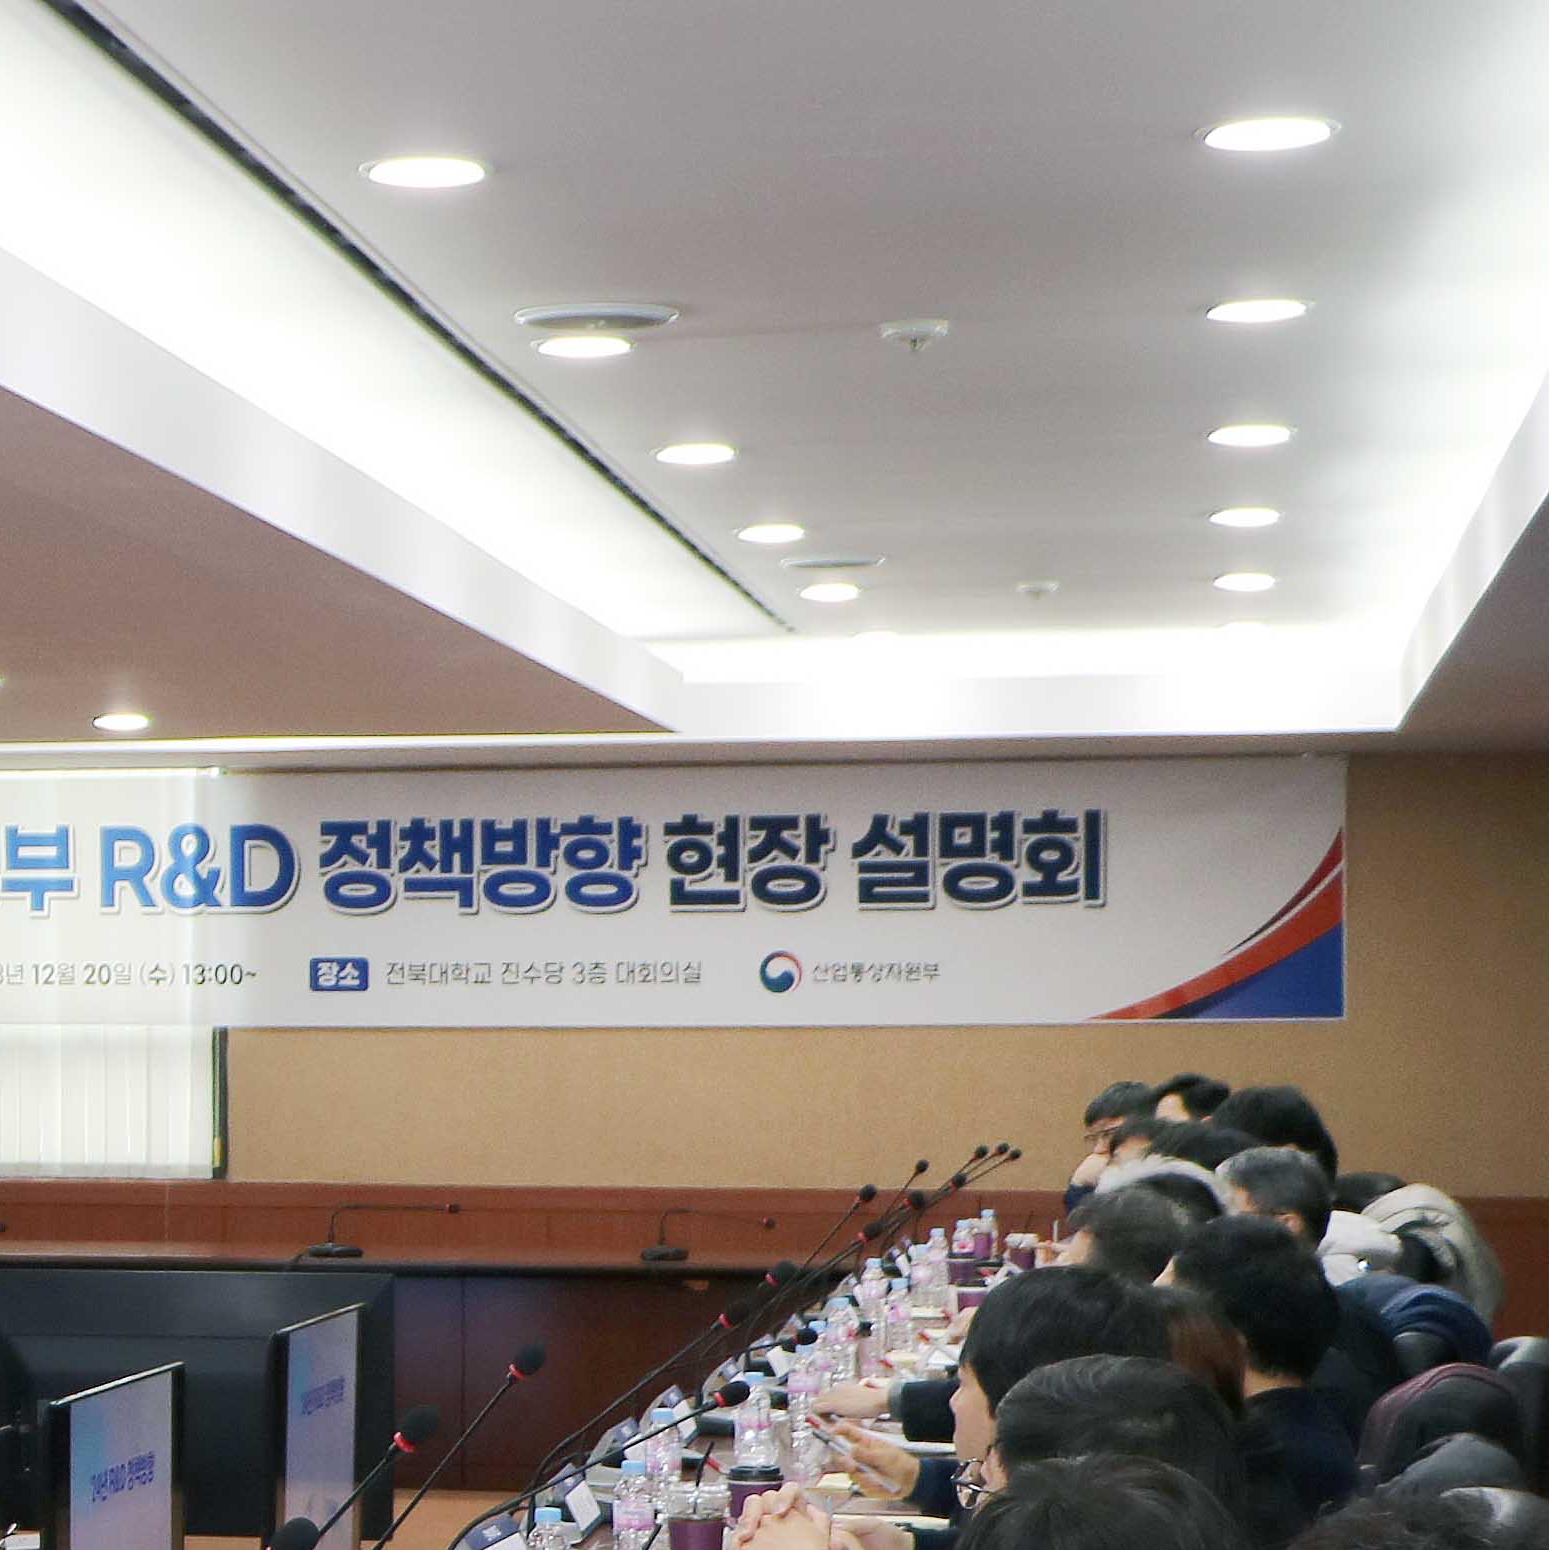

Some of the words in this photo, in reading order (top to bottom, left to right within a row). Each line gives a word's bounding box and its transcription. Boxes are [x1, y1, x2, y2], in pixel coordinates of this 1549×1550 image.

[99, 821, 301, 914] R&D
[318, 816, 649, 914] 정책방향
[663, 812, 837, 912] 현장
[852, 808, 1107, 910] 설명회
[31, 962, 77, 985] 12월
[85, 962, 134, 986] 20일
[138, 961, 176, 987] (수)
[312, 960, 364, 989] 장소
[386, 961, 495, 986] 전북대학교
[500, 961, 567, 986] 진수당
[572, 961, 609, 986] 3층
[615, 961, 704, 986] 대회의실
[811, 961, 943, 983] 산업통상자원부
